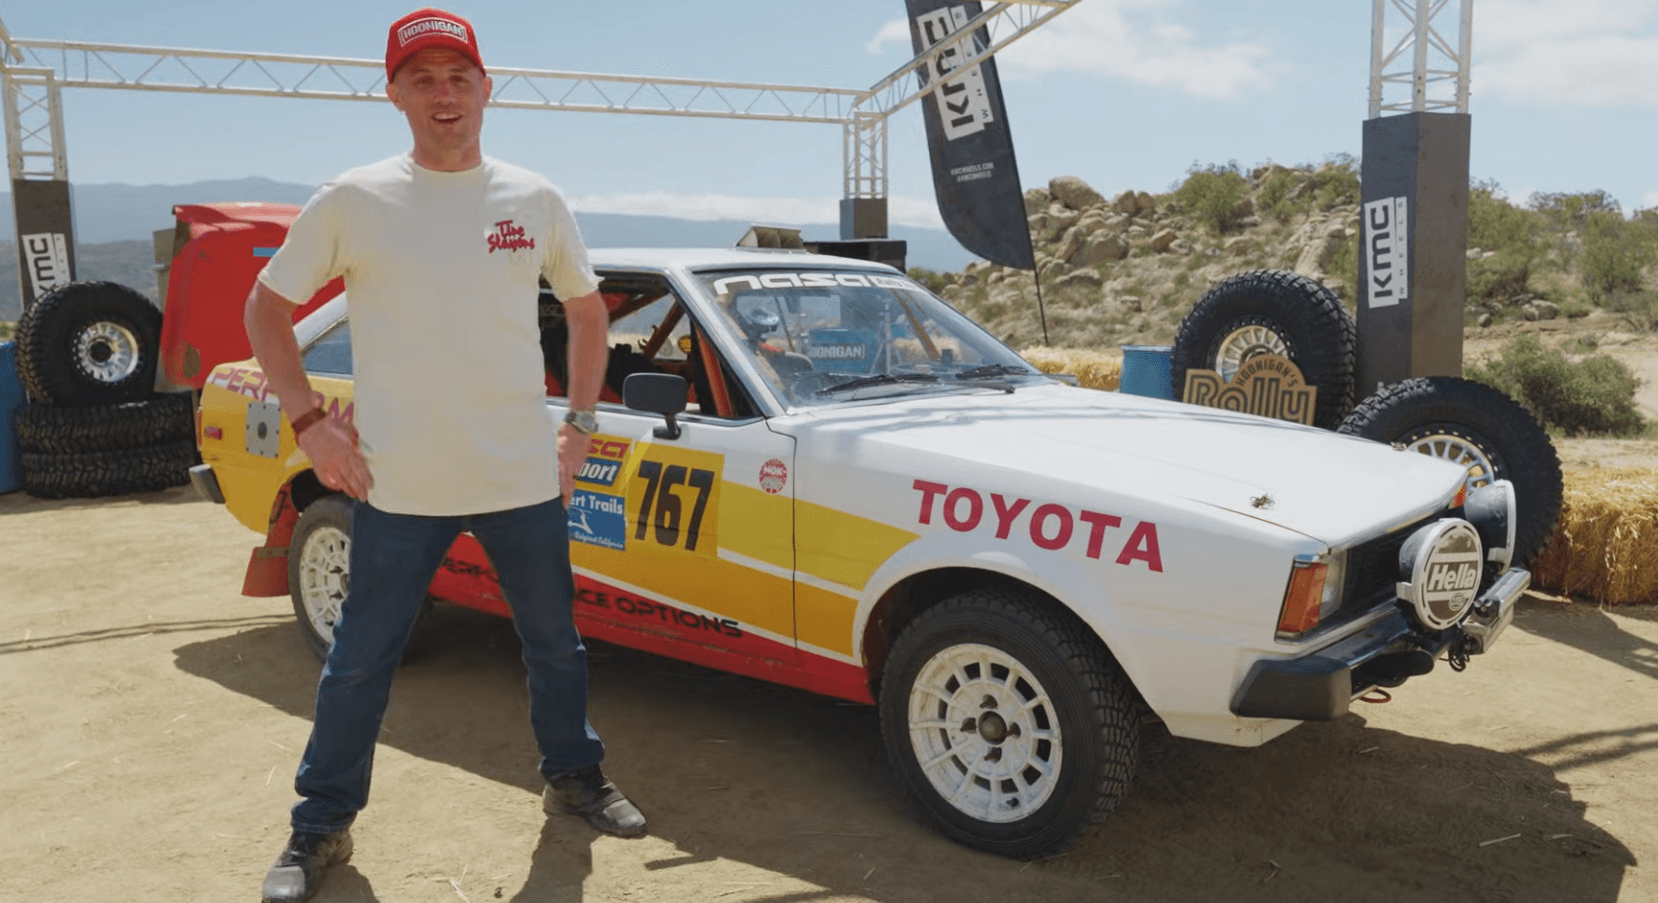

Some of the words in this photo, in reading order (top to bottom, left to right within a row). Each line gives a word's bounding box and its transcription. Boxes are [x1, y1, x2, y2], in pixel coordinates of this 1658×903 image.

[403, 20, 464, 39] HOONIGAN
[1235, 358, 1299, 387] HOONIGAN'S
[588, 495, 624, 515] Trails
[635, 460, 715, 551] 767
[912, 479, 1163, 573] TOYOTA
[1428, 563, 1477, 591] Hella
[616, 597, 743, 638] OPTIONS
